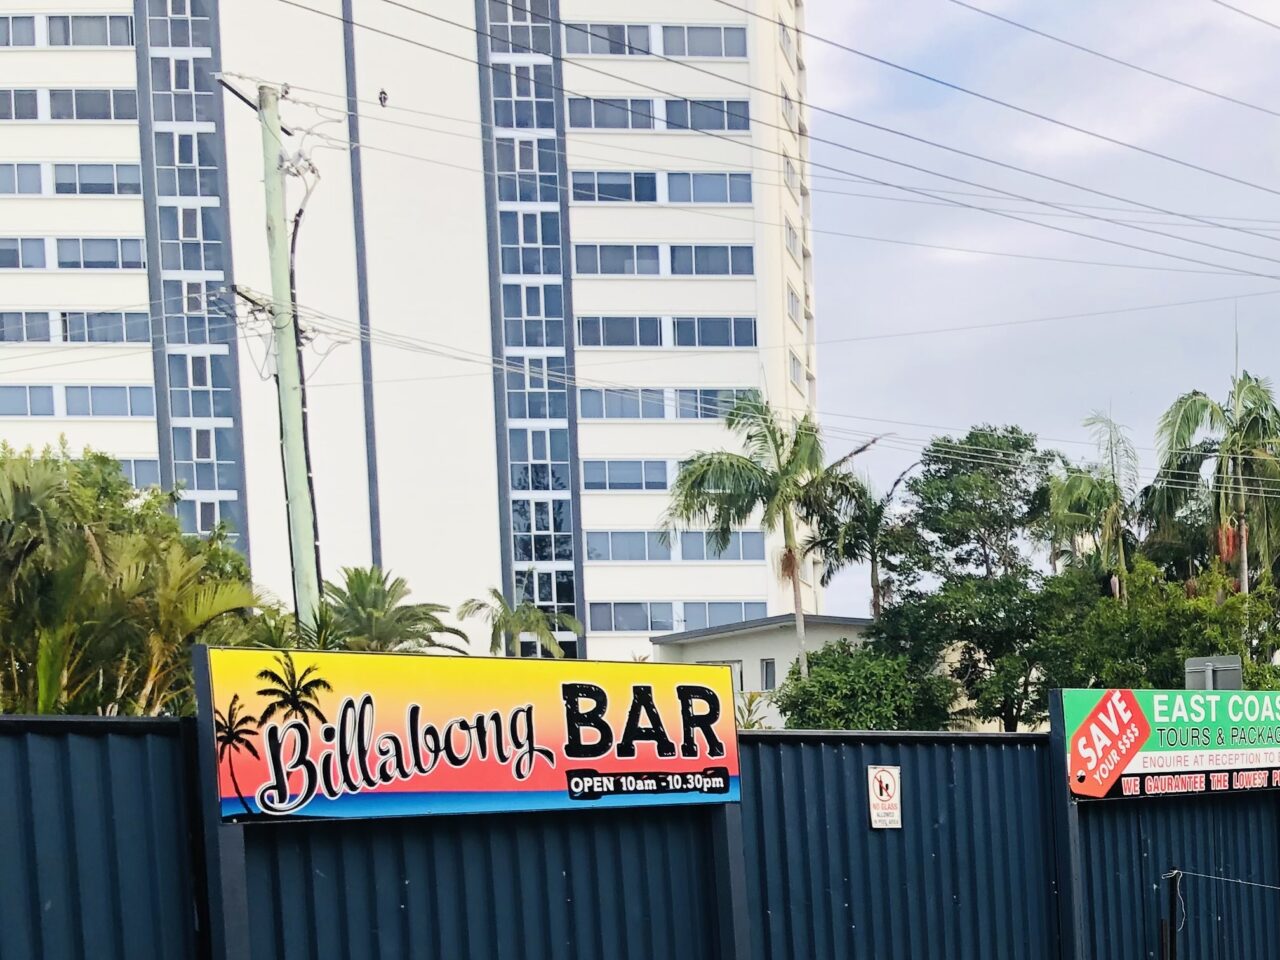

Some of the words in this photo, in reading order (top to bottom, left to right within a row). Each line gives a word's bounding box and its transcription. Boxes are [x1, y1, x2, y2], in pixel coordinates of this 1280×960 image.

[1153, 694, 1223, 723] EAST
[1076, 689, 1134, 770] SAVE
[1156, 727, 1211, 748] TOURS
[1215, 728, 1226, 746] &
[254, 692, 556, 816] Billabong
[561, 682, 725, 761] BAR
[1142, 753, 1189, 769] ENQUIRE
[1193, 754, 1205, 767] AT
[1208, 752, 1261, 766] RECEPTION
[1264, 752, 1276, 763] TO
[1092, 752, 1121, 786] YOUR
[570, 776, 615, 793] OPEN
[619, 775, 657, 792] 10am
[1121, 775, 1141, 796] WE
[1144, 772, 1206, 795] GAURANTEE
[1209, 771, 1229, 789] THE
[1232, 770, 1269, 788] LOWEST
